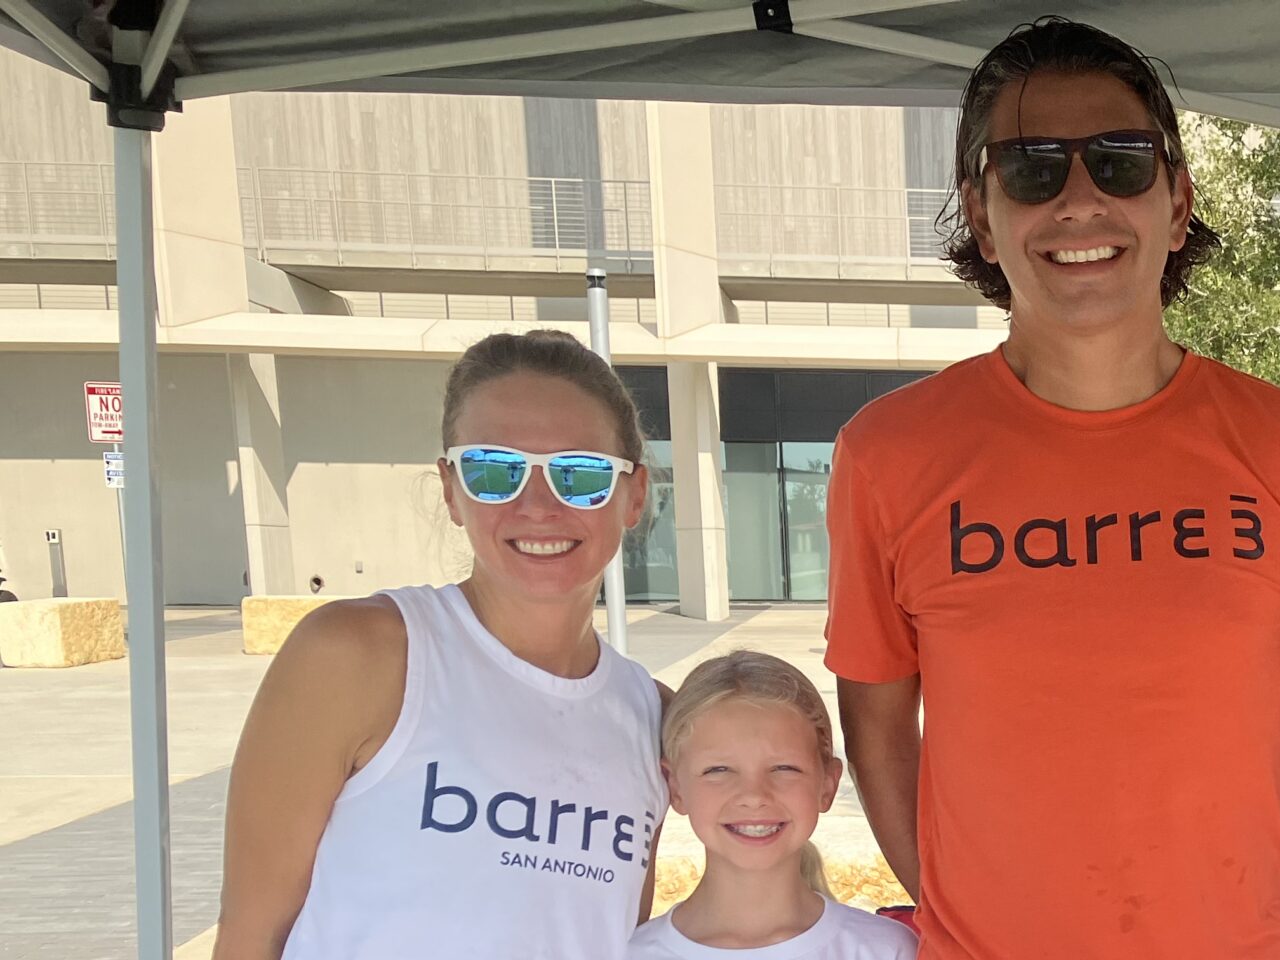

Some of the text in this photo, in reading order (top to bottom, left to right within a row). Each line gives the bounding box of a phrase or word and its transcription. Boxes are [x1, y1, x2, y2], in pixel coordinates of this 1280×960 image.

[99, 396, 122, 412] NO
[93, 412, 123, 421] PARKIN
[500, 851, 615, 883] SAN ANTONIO
